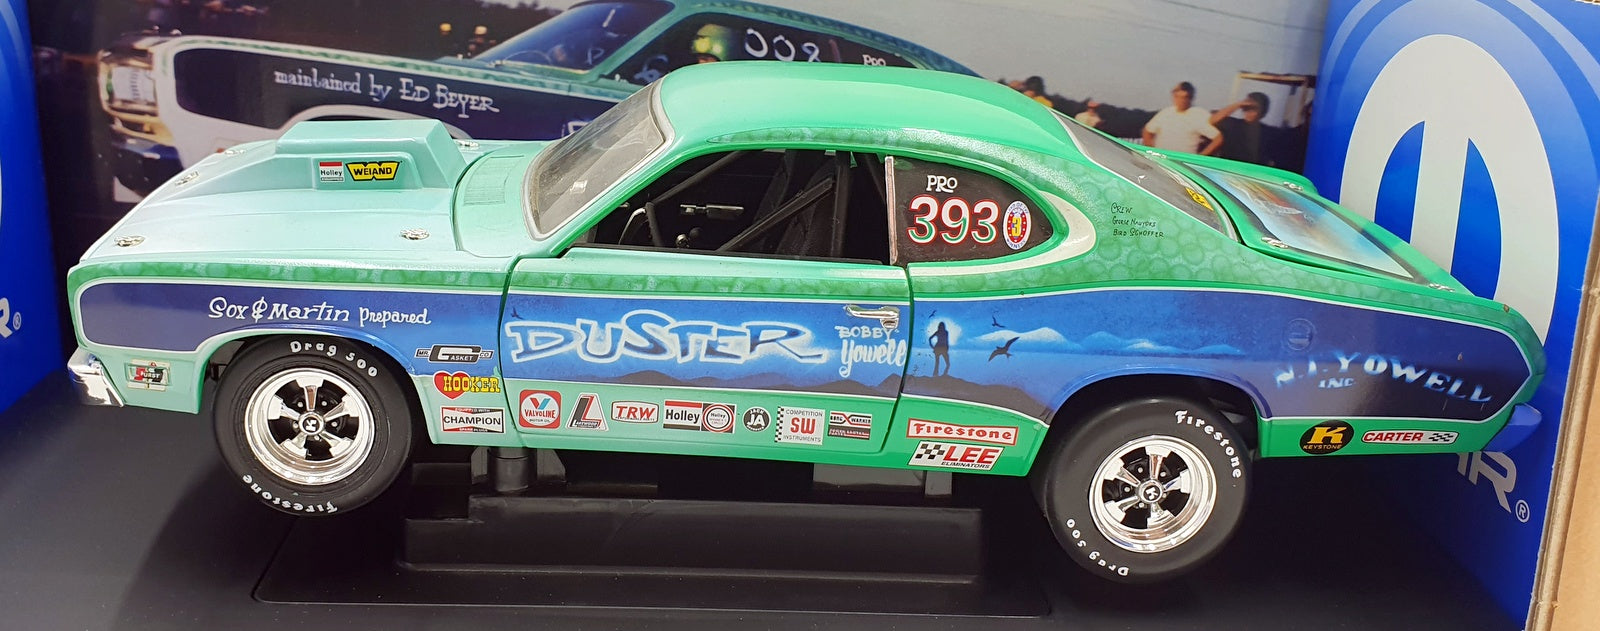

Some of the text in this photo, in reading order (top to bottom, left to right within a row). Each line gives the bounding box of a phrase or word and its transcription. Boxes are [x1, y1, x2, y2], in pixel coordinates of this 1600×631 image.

[274, 67, 361, 94] maintained
[369, 74, 392, 102] by
[400, 77, 430, 102] ED
[353, 167, 393, 176] WEIAND
[926, 174, 958, 193] PRO
[907, 194, 1001, 245] 393
[208, 297, 250, 319] Sox
[269, 301, 350, 322] Martin
[504, 309, 830, 364] DUSTER
[290, 341, 337, 356] Drag
[443, 376, 501, 393] HOOKER
[443, 415, 501, 425] CHAMPION
[616, 405, 656, 419] TRW
[665, 409, 700, 424] Holley
[747, 413, 766, 426] JA
[785, 409, 823, 417] COMPETITION
[790, 417, 816, 434] SW
[914, 422, 1012, 440] Firestone
[783, 434, 822, 442] INSTRUMENTS
[1307, 426, 1347, 444] K
[1363, 432, 1424, 442] CARTER
[1175, 410, 1242, 478] Firestone
[943, 445, 999, 464] LEE
[941, 461, 991, 469] ELIMINATORS
[242, 474, 338, 513] Firestone
[1088, 551, 1130, 576] Drag
